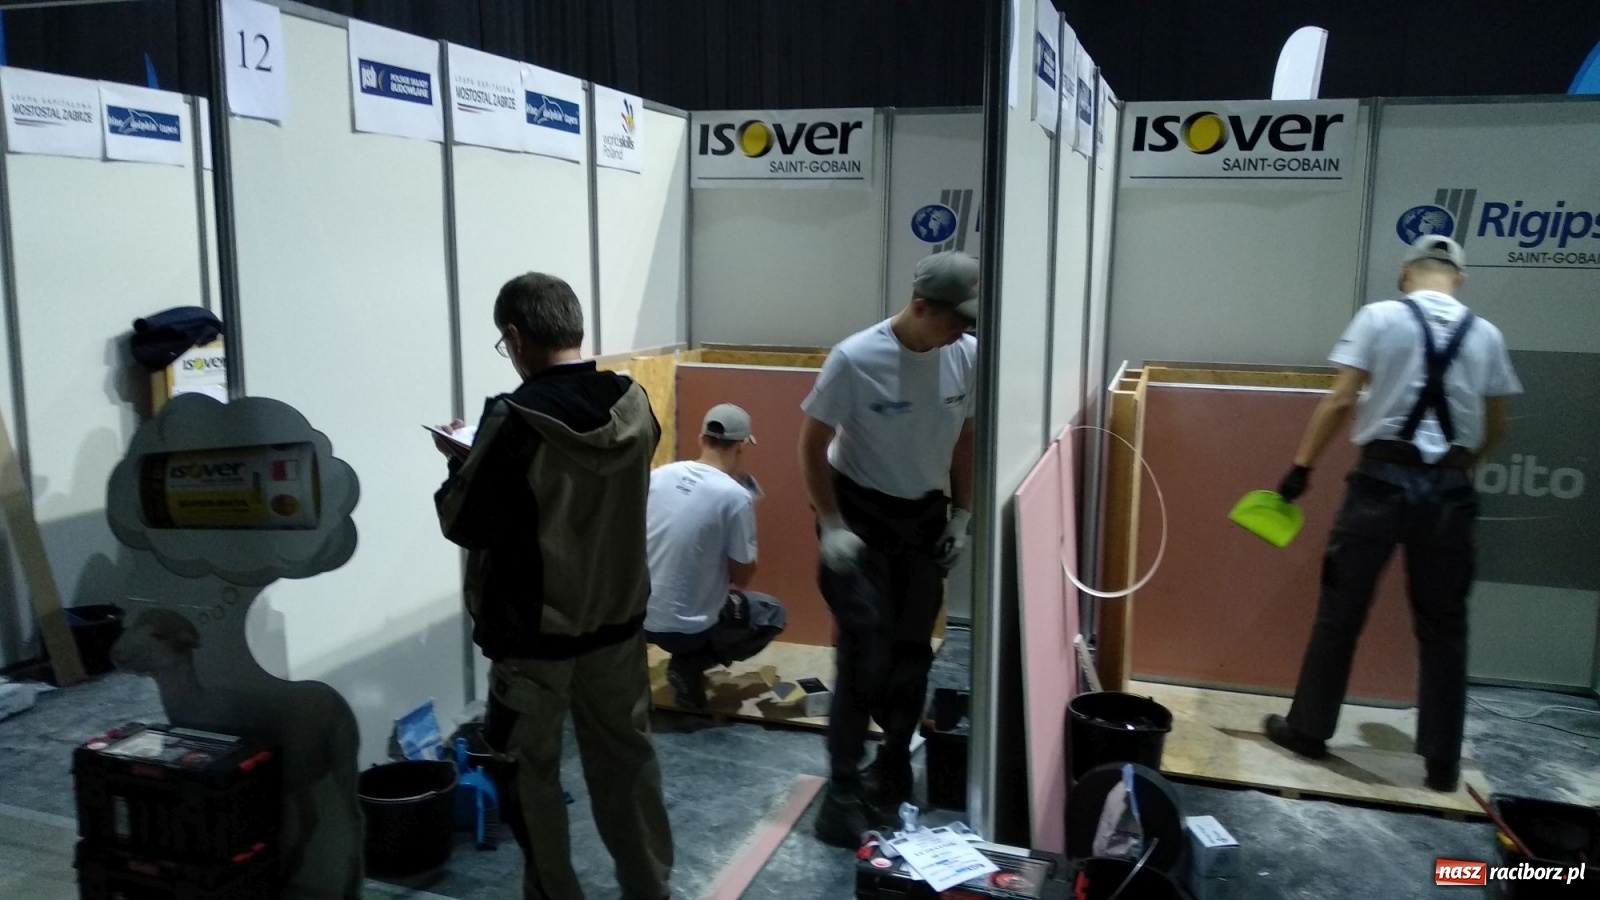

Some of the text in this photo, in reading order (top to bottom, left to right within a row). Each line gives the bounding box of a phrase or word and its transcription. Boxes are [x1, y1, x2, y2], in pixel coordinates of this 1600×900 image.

[237, 29, 272, 73] 12
[455, 85, 493, 106] MOSTOSTAL
[12, 102, 62, 120] MOSTOSTAL
[769, 160, 861, 174] SAINT-GOBAIN
[1222, 157, 1340, 173] SAINT-GOBAIN
